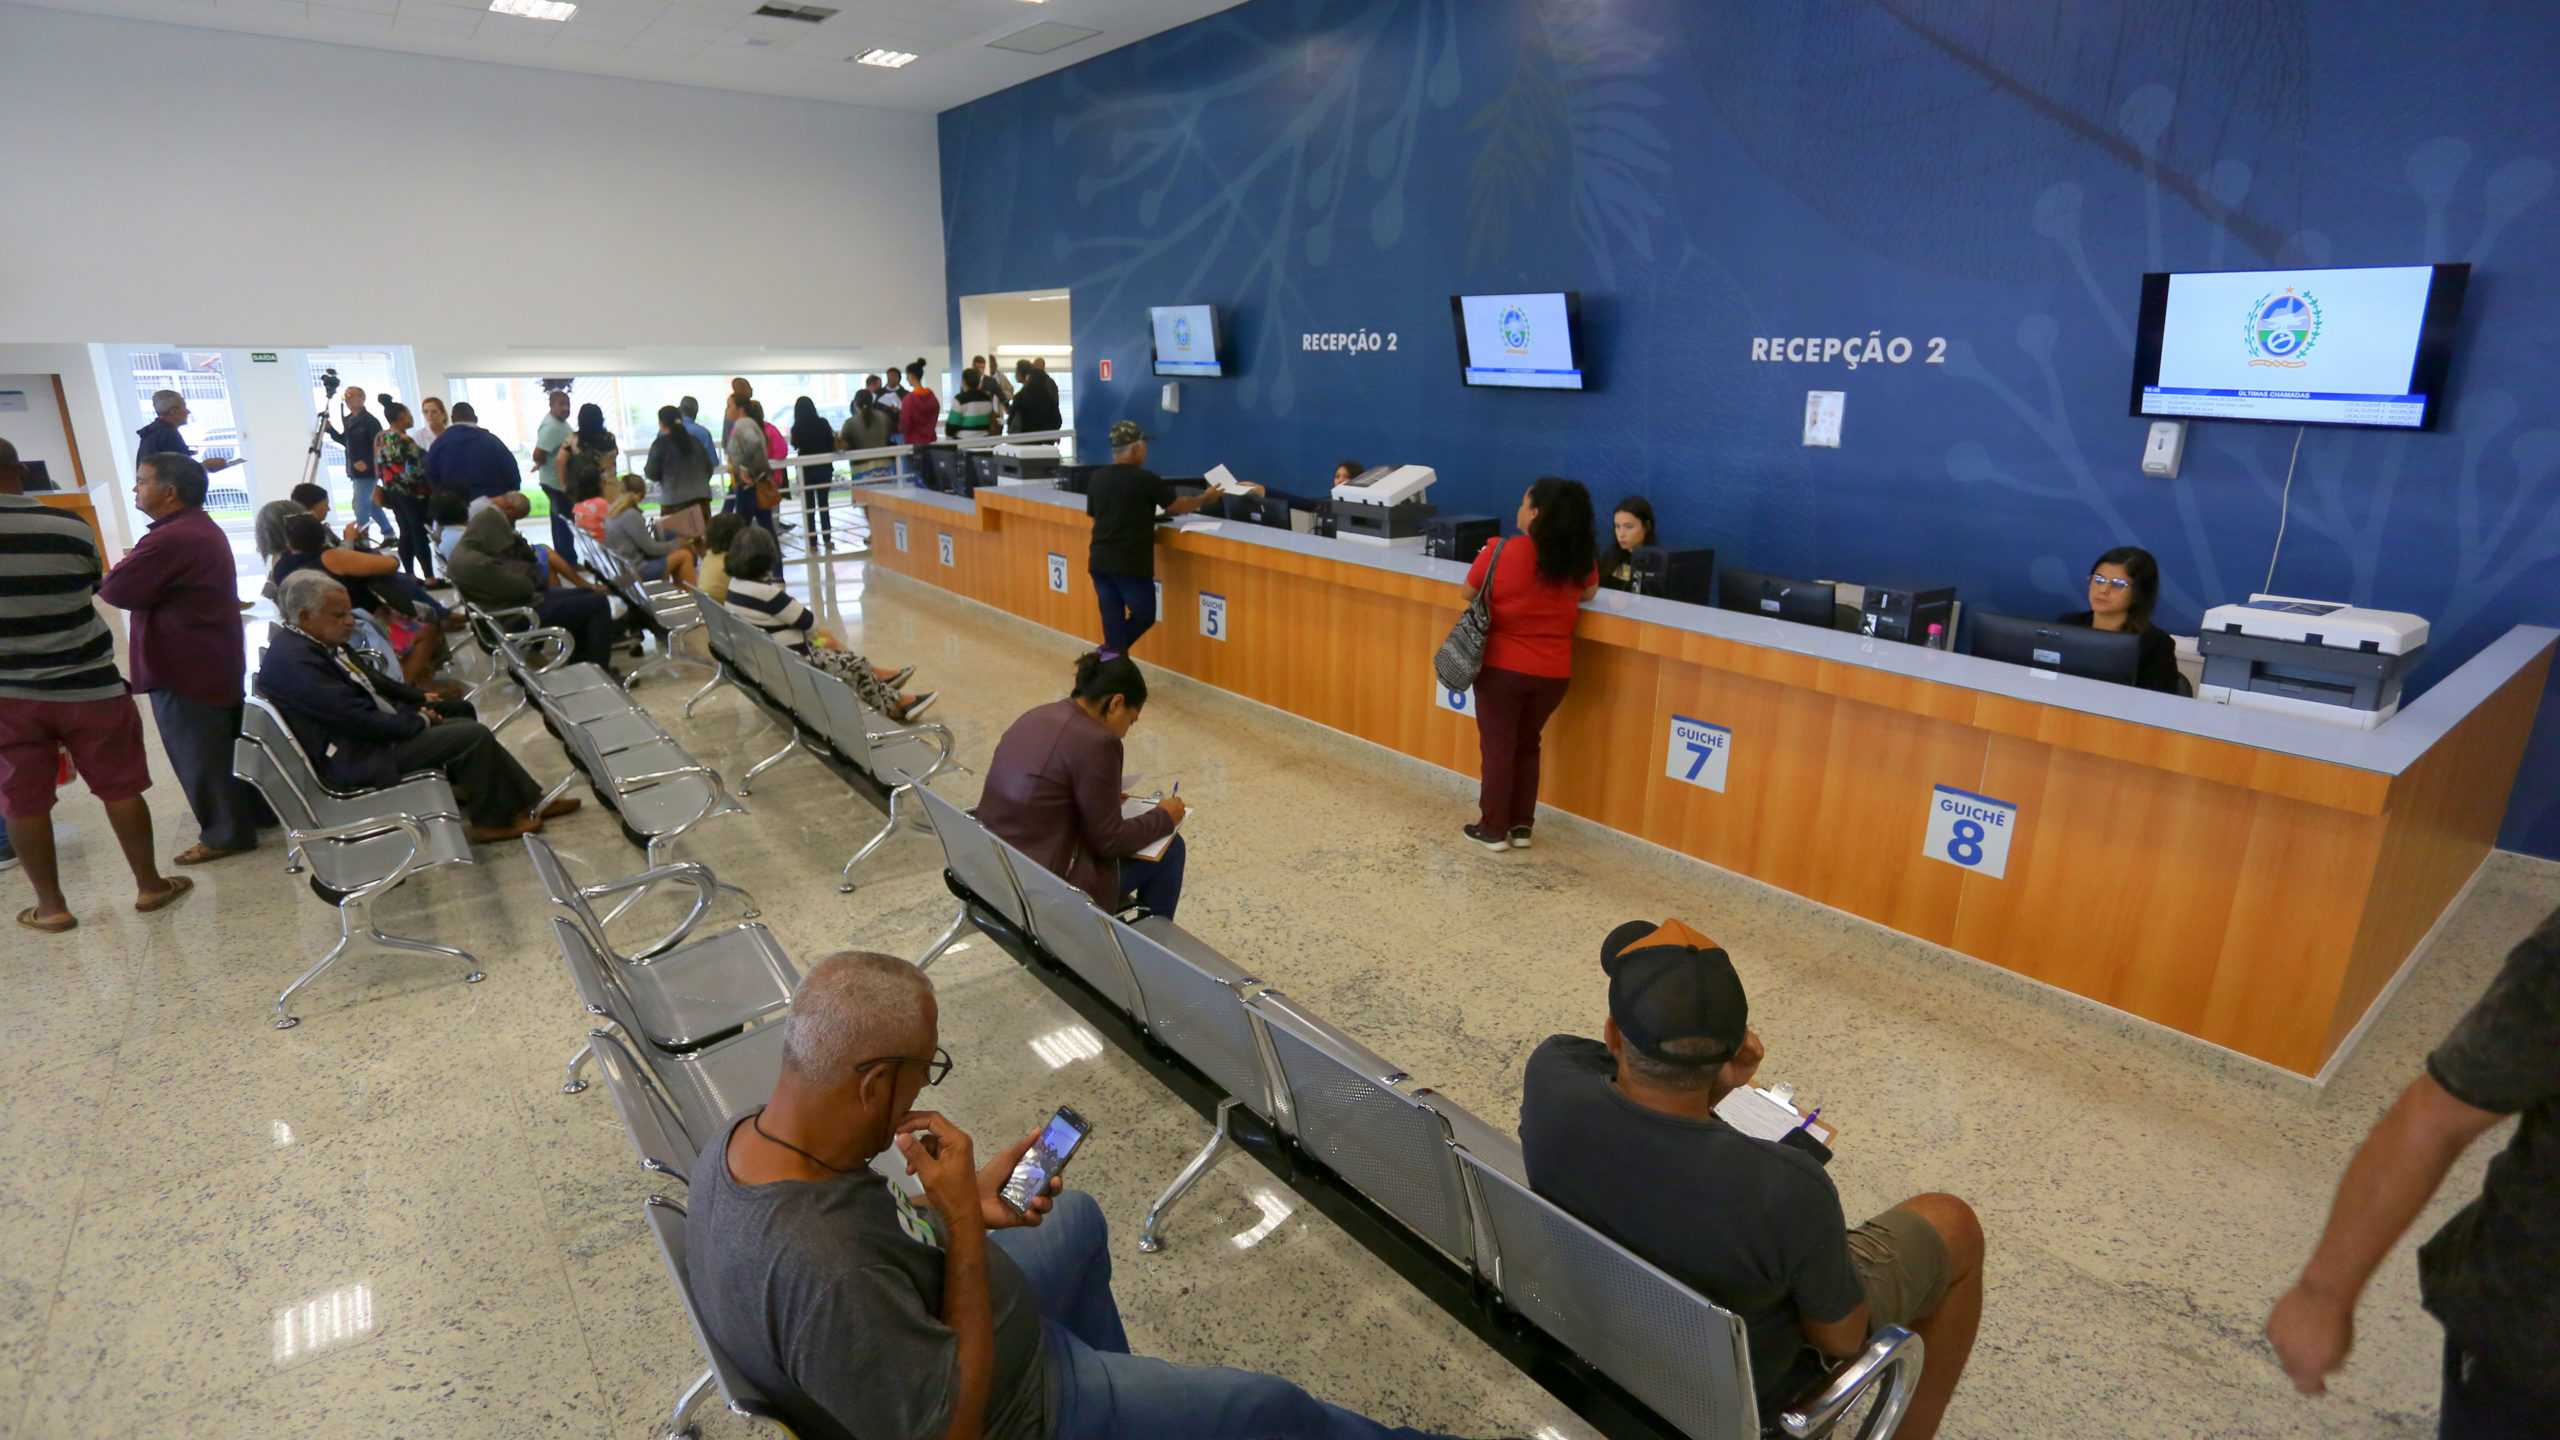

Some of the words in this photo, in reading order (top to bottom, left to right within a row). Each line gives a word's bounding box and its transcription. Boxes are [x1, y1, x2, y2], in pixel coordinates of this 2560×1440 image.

[1302, 328, 1381, 356] RECEPÇÃO
[1387, 332, 1398, 351] 2
[1751, 330, 1913, 370] RECEPÇÃO
[1925, 336, 1947, 363] 2
[2269, 391, 2310, 399] CHAMADAS
[898, 531, 904, 550] 1
[943, 544, 950, 563] 2
[1054, 567, 1062, 589] 3
[1207, 609, 1218, 636] 5
[1677, 726, 1724, 748] GUICHÊ
[1685, 741, 1713, 780] 7
[1940, 799, 2005, 827] GUICHÊ
[1947, 819, 1984, 866] 8
